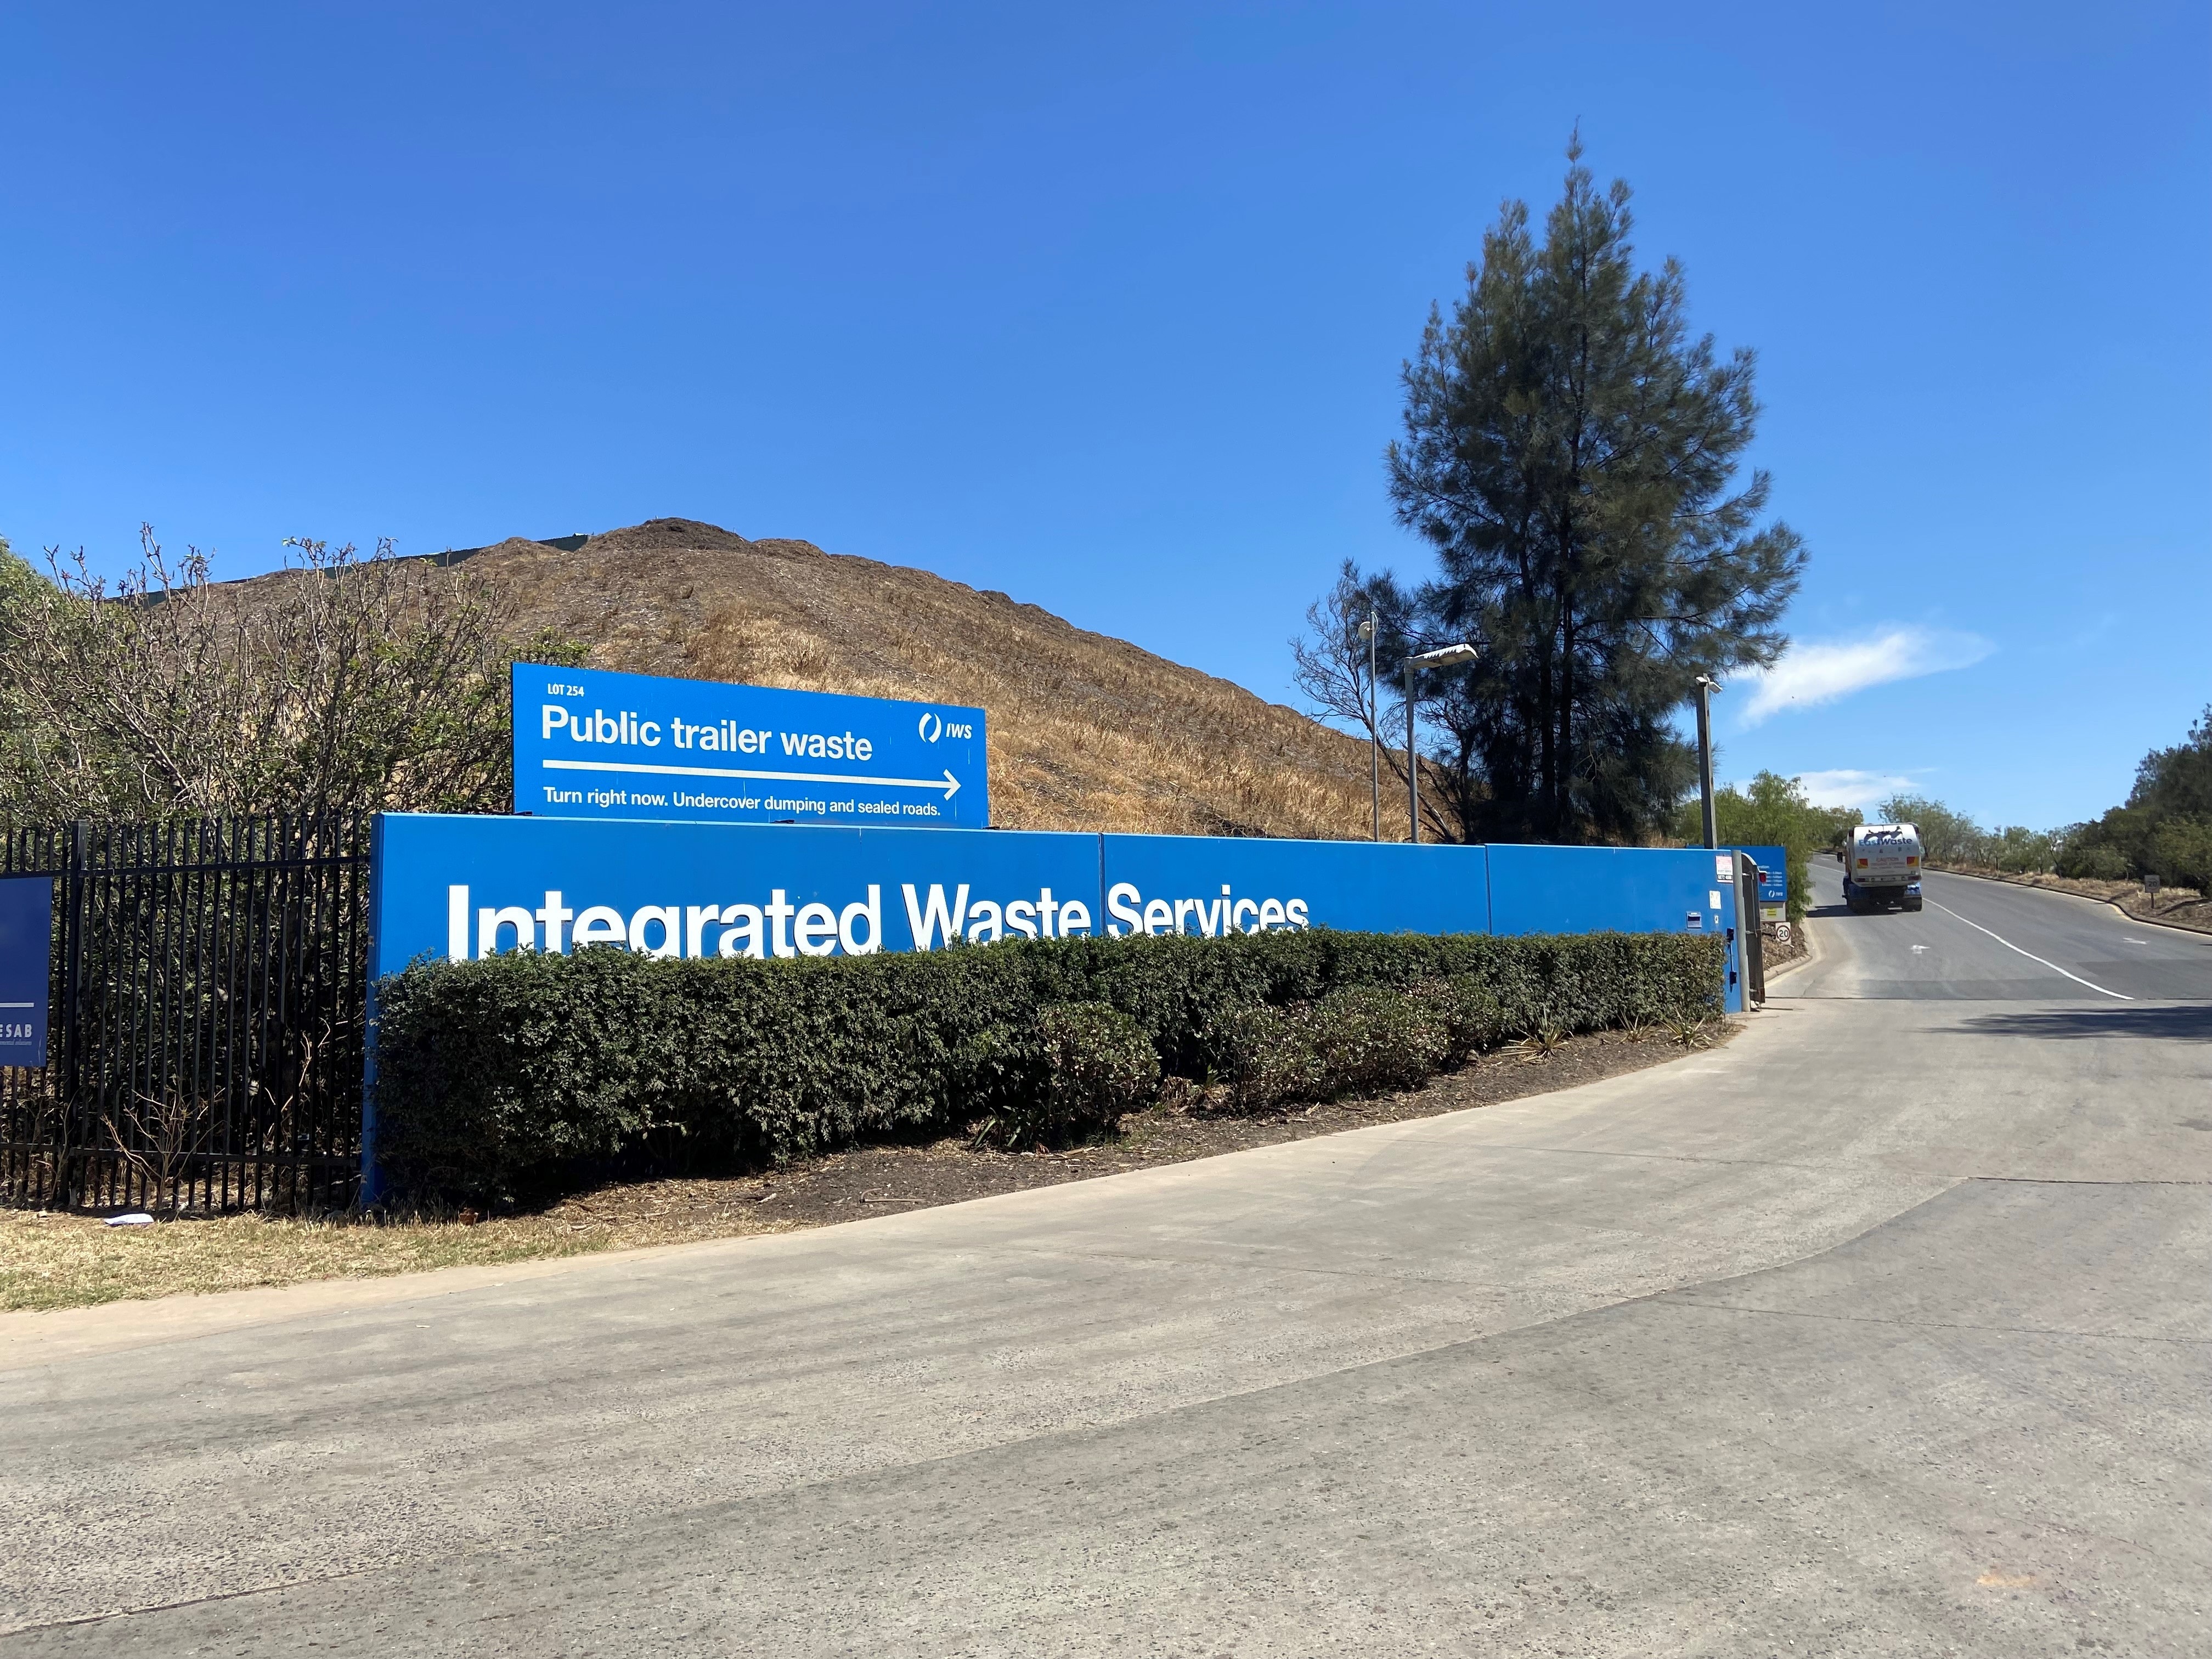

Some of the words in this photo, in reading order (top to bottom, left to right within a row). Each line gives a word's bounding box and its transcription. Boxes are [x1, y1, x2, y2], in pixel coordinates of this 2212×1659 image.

[548, 683, 565, 696] LOT
[566, 685, 585, 697] 254
[542, 704, 662, 747] Public
[670, 716, 772, 754] trailer
[780, 731, 873, 761] waste
[945, 723, 973, 740] IWS
[543, 786, 583, 804] Turn
[587, 788, 627, 808] right
[631, 792, 668, 806] now.
[673, 791, 761, 809] Undercover
[764, 795, 826, 815] dumping
[829, 799, 855, 813] and
[857, 800, 900, 815] sealed
[902, 802, 941, 816] roads.
[448, 884, 881, 964] Integrated
[901, 883, 1092, 952] Waste
[1107, 882, 1310, 938] Services
[1779, 929, 1788, 938] 20
